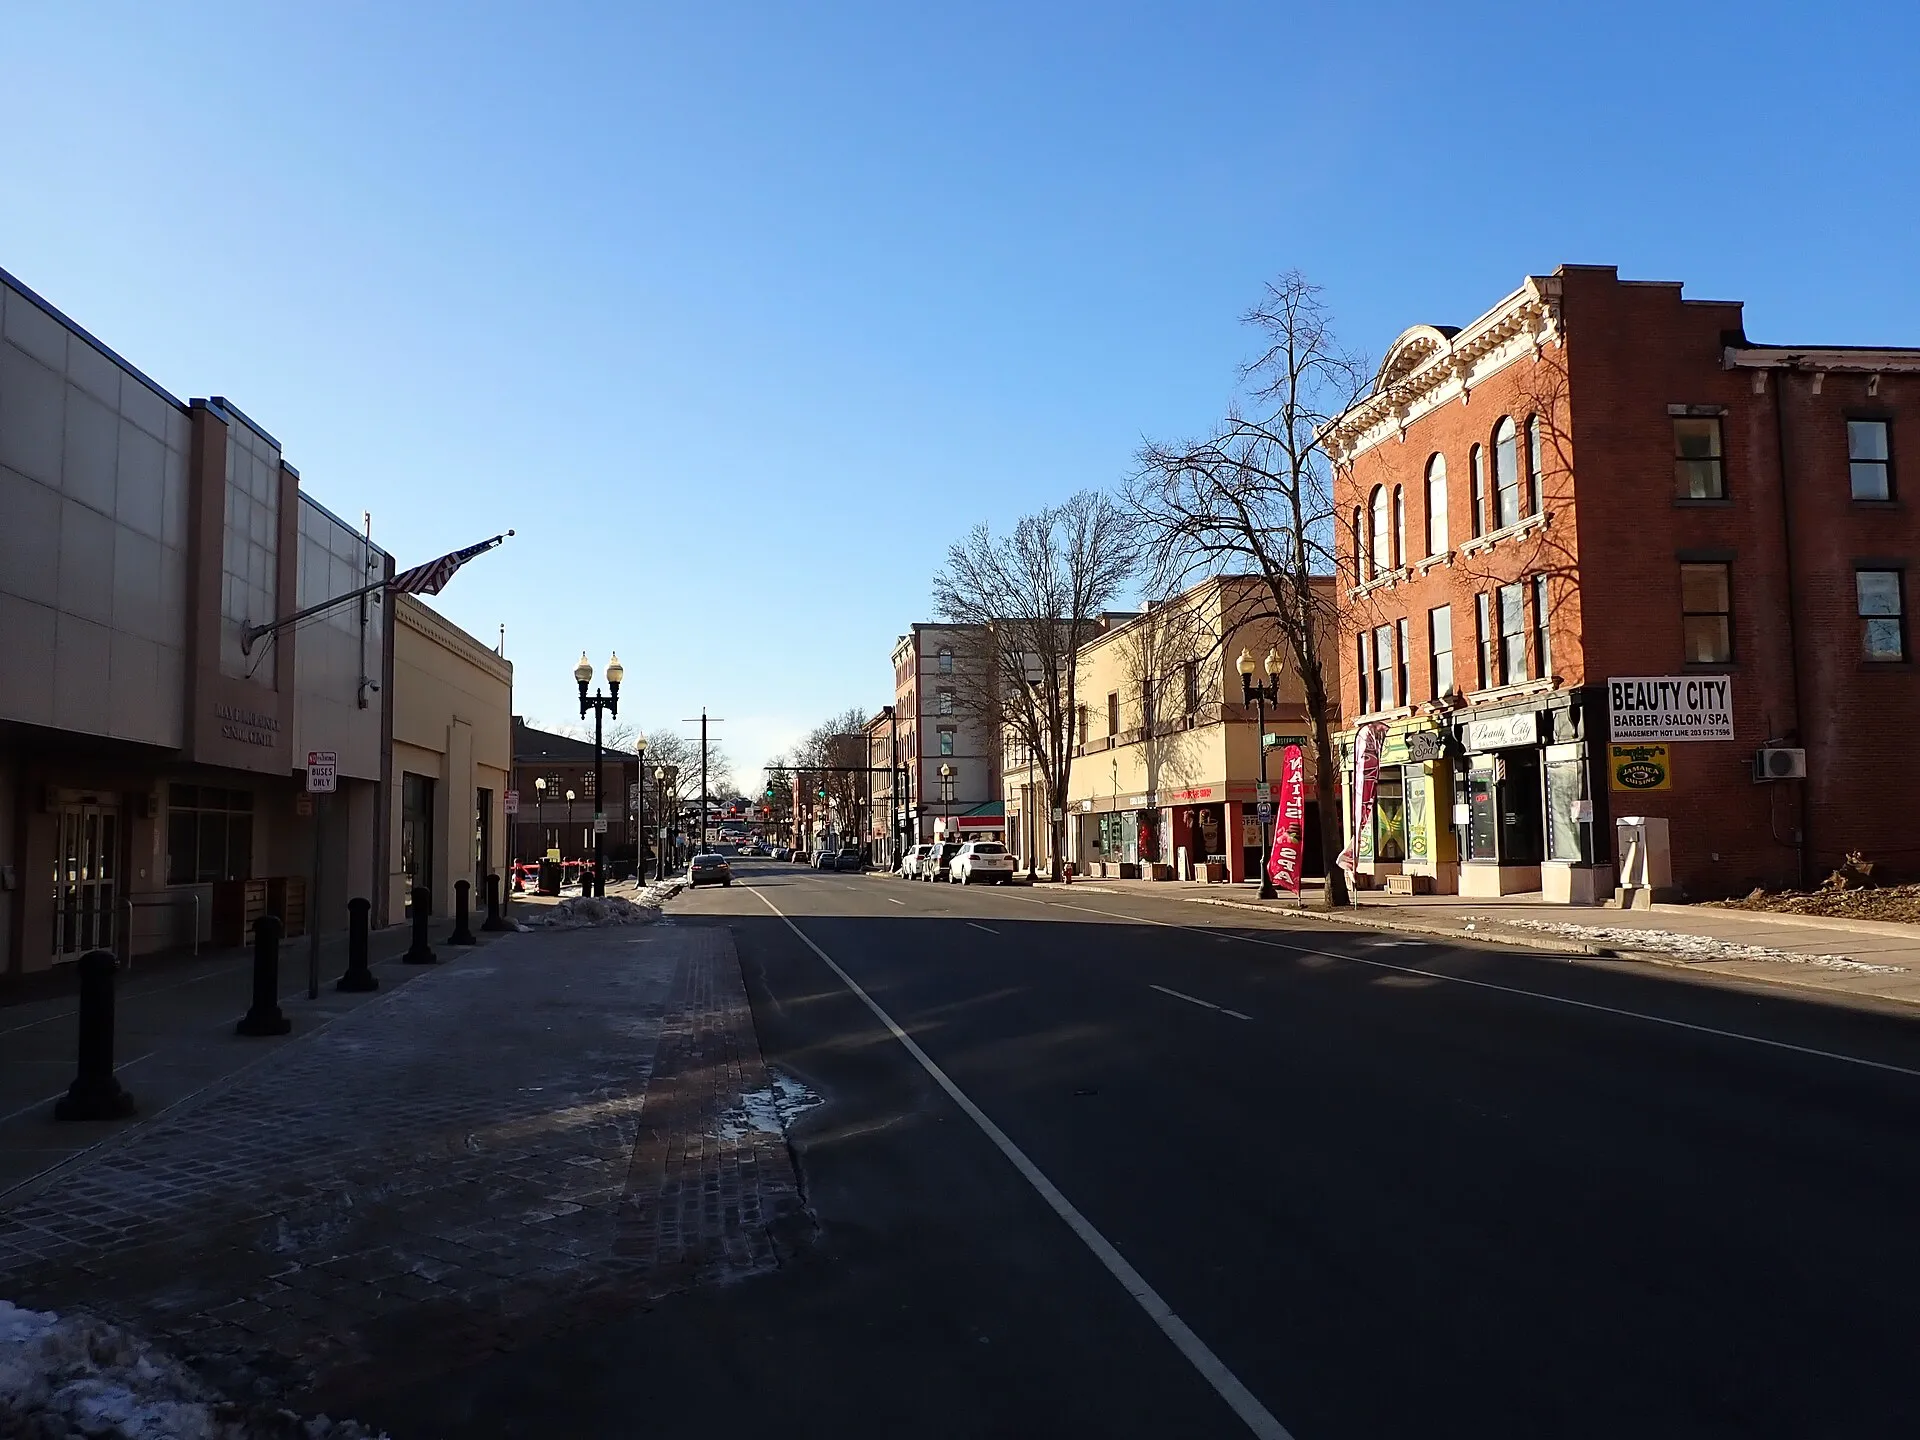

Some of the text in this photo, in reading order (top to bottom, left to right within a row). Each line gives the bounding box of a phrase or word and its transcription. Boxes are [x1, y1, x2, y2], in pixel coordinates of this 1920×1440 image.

[1612, 680, 1727, 711] BEAUTY CITY
[1472, 718, 1532, 742] Beauty City
[1614, 730, 1659, 738] MANAGEMENT
[1415, 744, 1434, 759] Spa
[312, 768, 333, 776] BUSES
[1622, 765, 1659, 776] JAMAICA
[313, 778, 331, 787] ONLY
